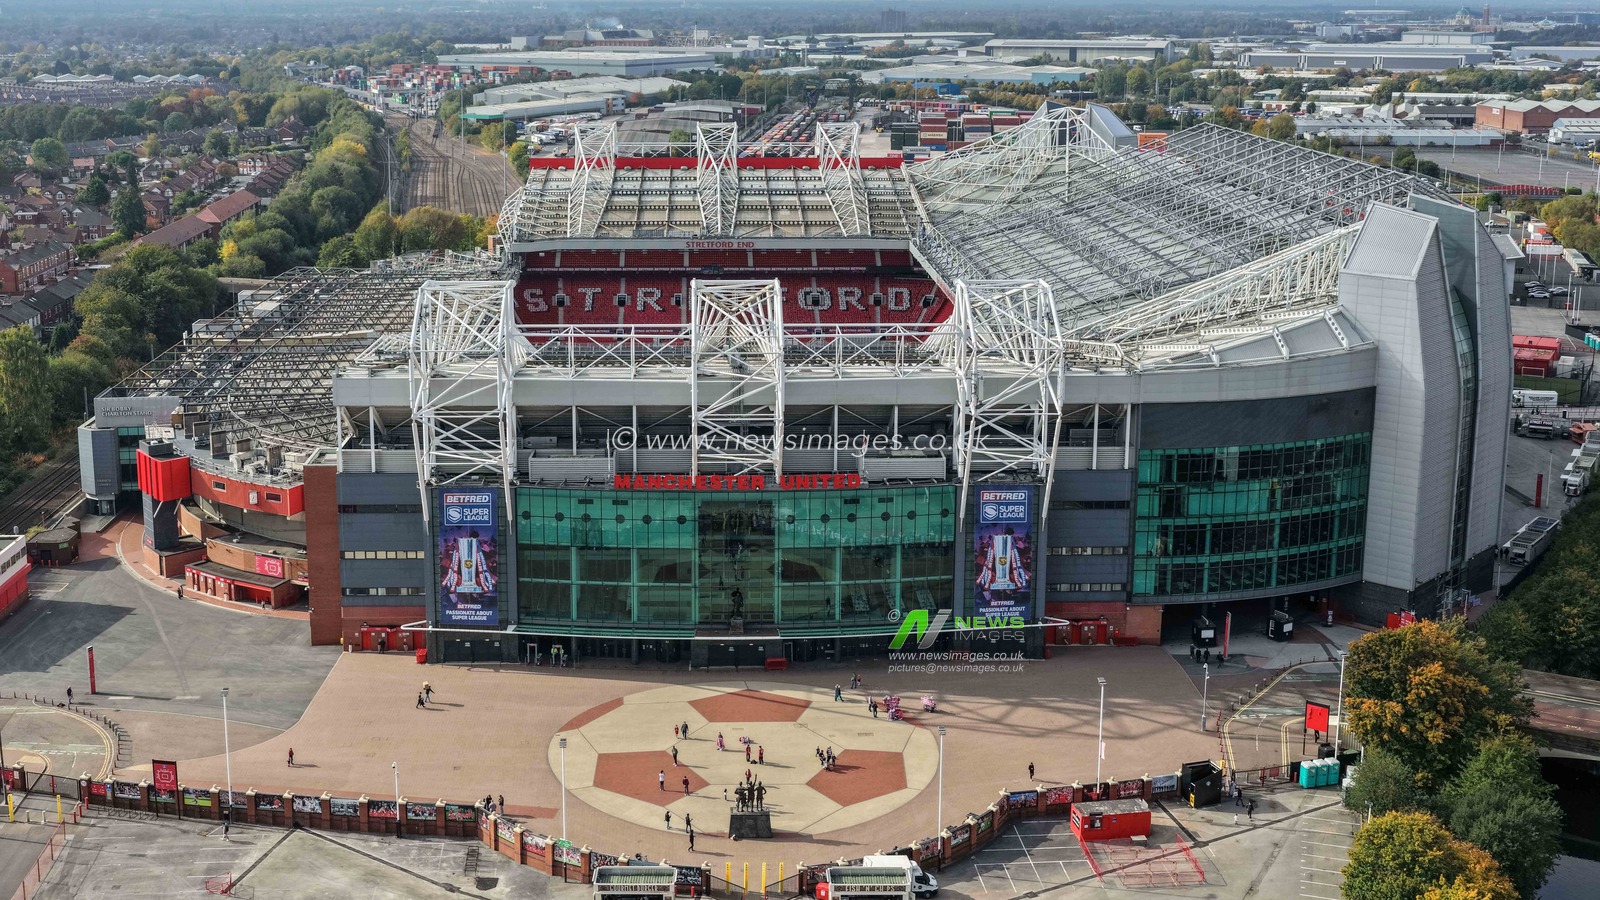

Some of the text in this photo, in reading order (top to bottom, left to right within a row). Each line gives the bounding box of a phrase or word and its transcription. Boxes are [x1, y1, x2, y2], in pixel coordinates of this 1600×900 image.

[614, 473, 861, 490] MANCHESTER UNITED
[446, 495, 490, 503] BETFRED
